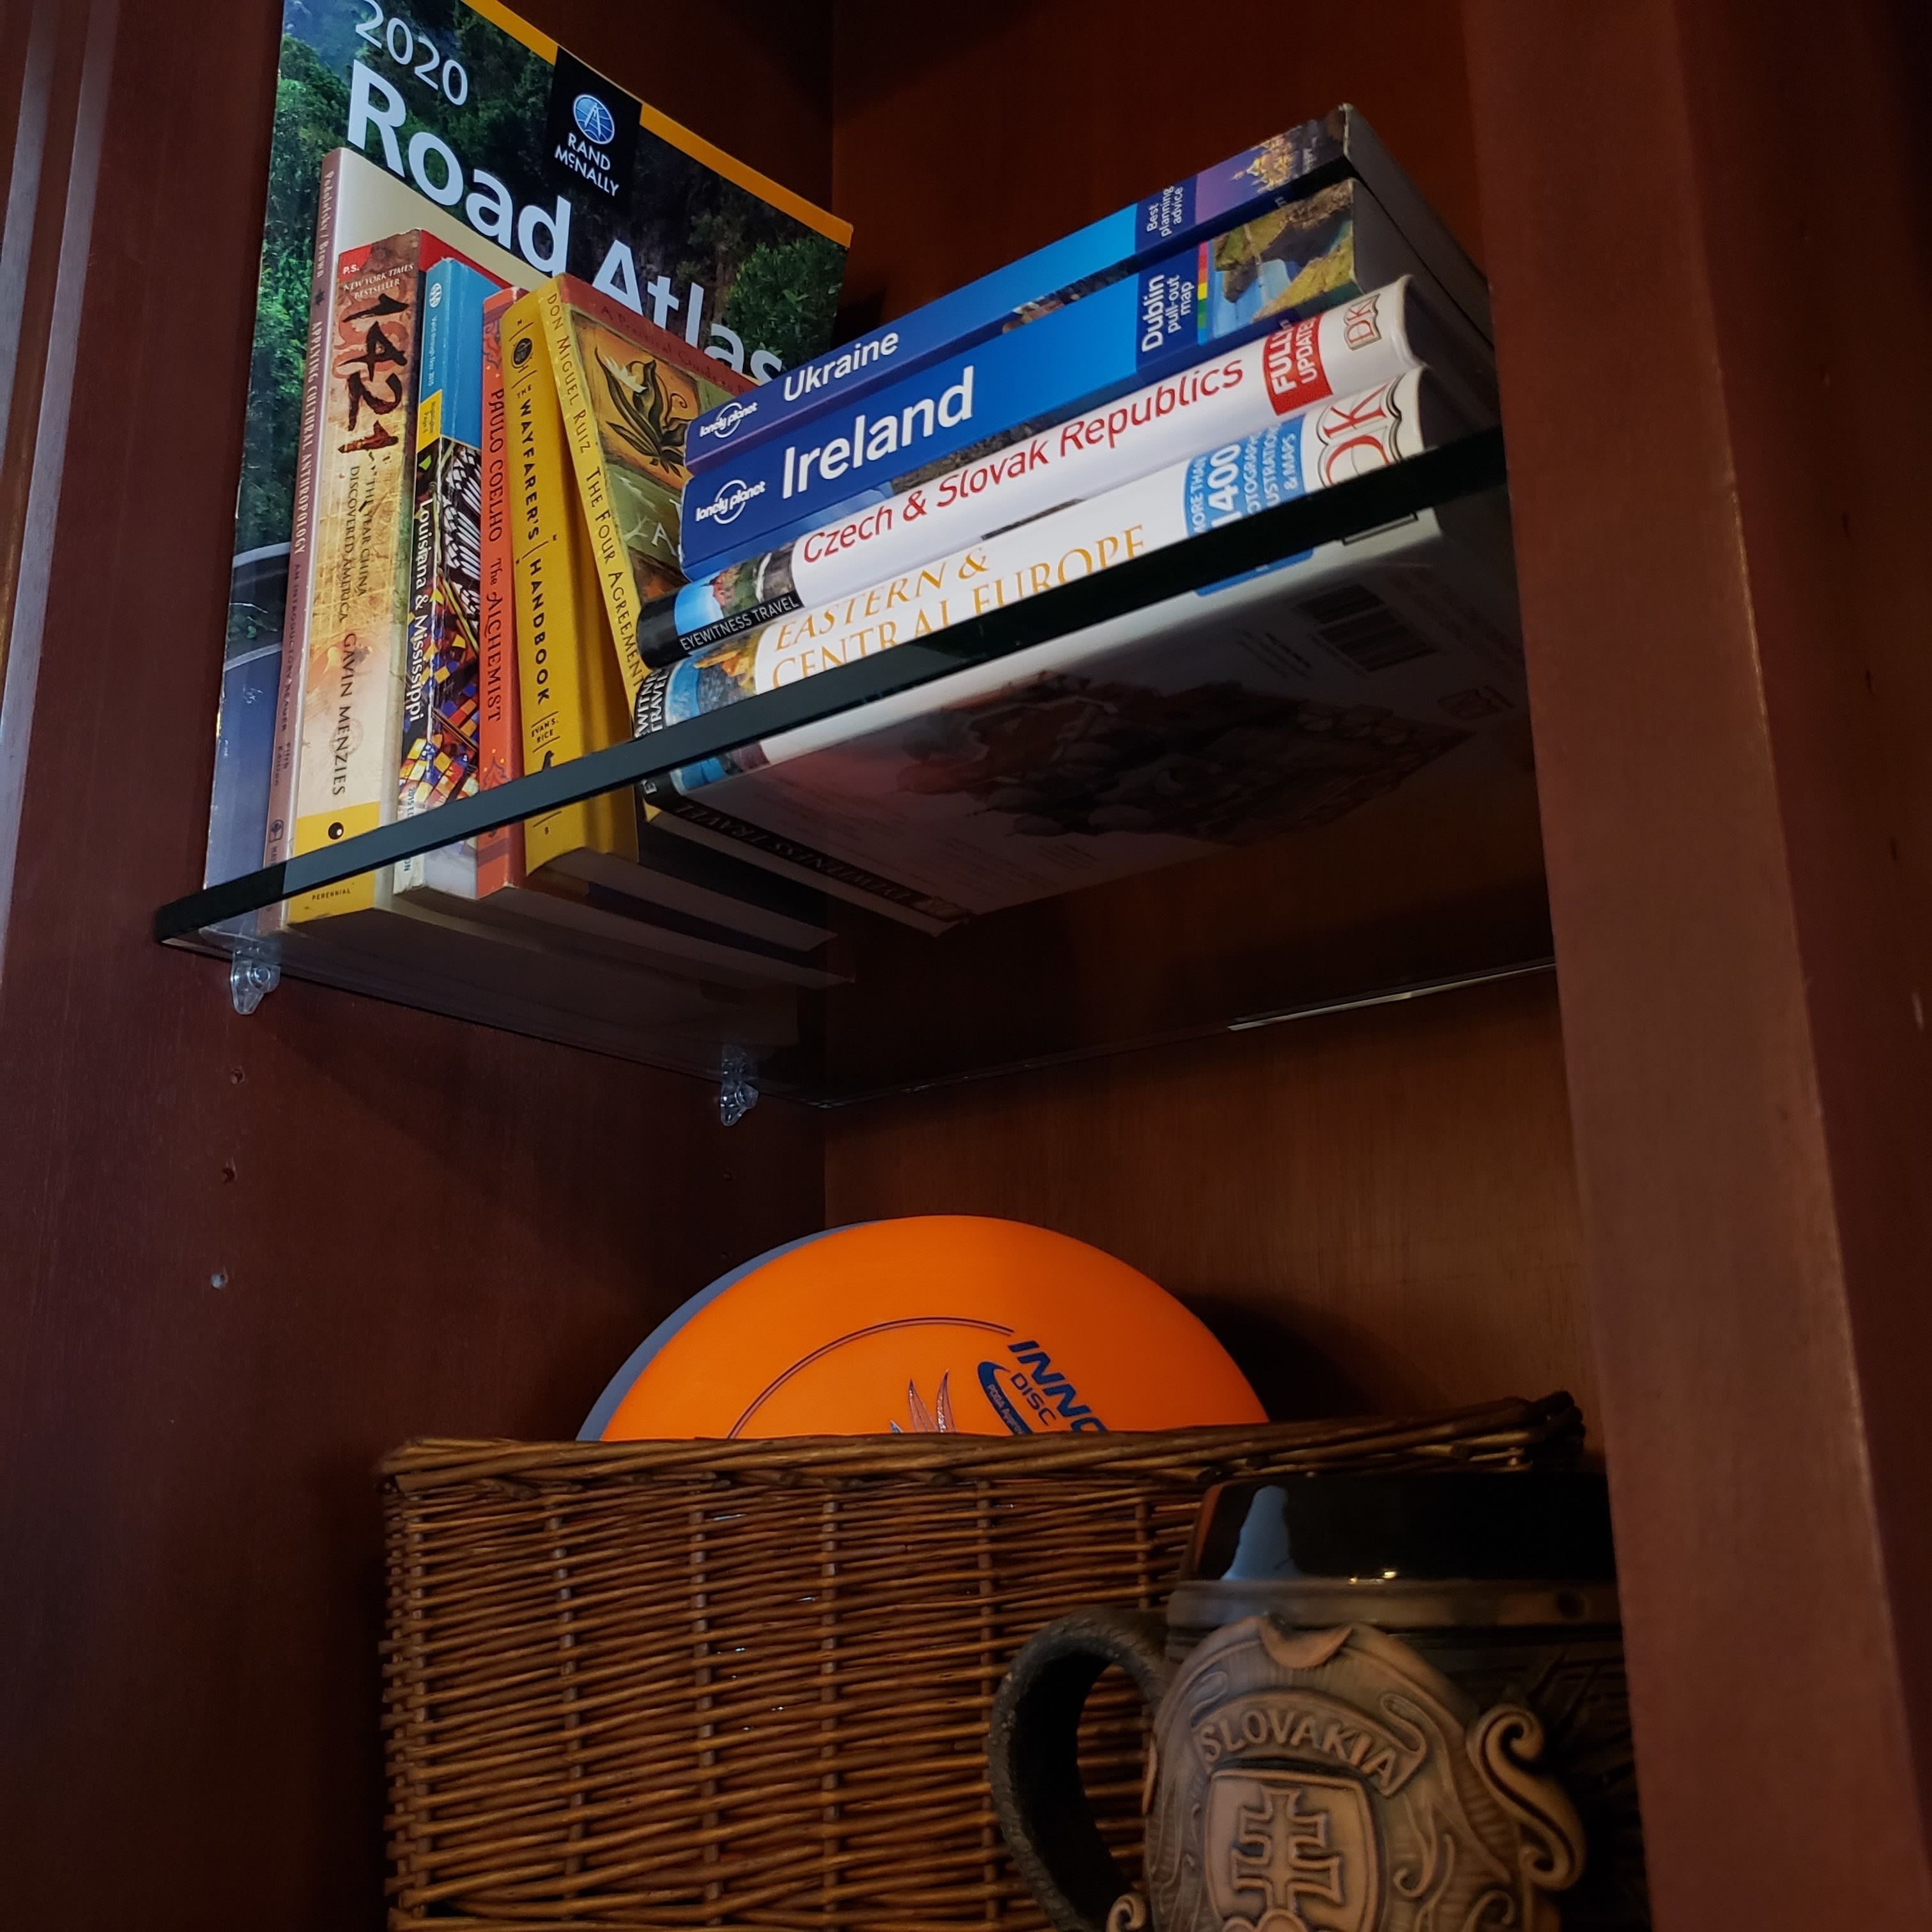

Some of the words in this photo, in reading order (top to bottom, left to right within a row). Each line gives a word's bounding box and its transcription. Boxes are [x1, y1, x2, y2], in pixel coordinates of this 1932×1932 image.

[355, 0, 468, 106] 2020
[555, 145, 619, 197] McNALLY
[567, 133, 611, 171] RAND
[348, 59, 572, 276] Road
[592, 240, 783, 383] Atlas
[1147, 203, 1158, 233] Best
[1160, 185, 1174, 238] planning
[1173, 187, 1184, 224] advice
[317, 241, 329, 278] Brown
[342, 280, 365, 292] NEW
[365, 273, 387, 286] YORK
[388, 263, 415, 277] TIMES
[343, 264, 360, 275] P.S.
[353, 278, 401, 300] BESTSELLER
[546, 293, 564, 332] DON
[1142, 274, 1165, 353] Dublin
[1167, 275, 1181, 333] pull-out
[1180, 281, 1195, 316] map
[1346, 297, 1376, 344] DK
[308, 321, 323, 383] APPLYING
[337, 293, 410, 454] 1421
[556, 337, 582, 406] MIGUEL
[783, 332, 900, 402] Ukraine
[303, 386, 318, 450] CULTURAL
[488, 389, 505, 454] PAULO
[574, 410, 591, 454] RUIZ
[699, 413, 728, 438] lonely
[726, 401, 758, 428] planet
[782, 365, 975, 500] Ireland
[803, 510, 892, 563] Czech
[902, 489, 928, 521] &
[936, 439, 1050, 509] Slovak
[1059, 359, 1244, 457] Republics
[1190, 456, 1207, 493] THAN
[1281, 433, 1296, 477] MAPS
[293, 454, 312, 555] ANTHROPOLOGY
[344, 466, 360, 554] DISCOVERED
[364, 479, 375, 505] THE
[487, 458, 504, 543] COELHO
[585, 467, 604, 508] THE
[695, 496, 730, 522] lonely
[727, 480, 767, 510] planet
[1283, 477, 1299, 490] &
[362, 510, 374, 545] YEAR
[415, 498, 434, 590] Louisiana
[519, 398, 541, 541] WAYFARER'S
[530, 558, 551, 705] HANDBOOK
[596, 510, 620, 565] FOUR
[339, 558, 353, 622] AMERICA
[358, 548, 371, 597] CHINA
[489, 558, 502, 585] The
[776, 561, 947, 651] EASTERN
[957, 546, 989, 581] &
[415, 594, 424, 608] &
[680, 612, 753, 652] EYEWITNESS
[752, 596, 800, 623] TRAVEL
[606, 571, 645, 687] AGREEMENT
[341, 632, 359, 698] GAVIN
[405, 614, 430, 723] Mississippi
[486, 591, 504, 723] ALCHEMIST
[651, 670, 670, 732] TRAVEL
[332, 705, 351, 797] MENZIES
[531, 722, 547, 739] EVAN
[536, 729, 555, 743] RICE
[312, 887, 351, 901] PERENNIAL
[1010, 1372, 1057, 1427] DISC
[1199, 1708, 1398, 1787] SLOVAKIA
